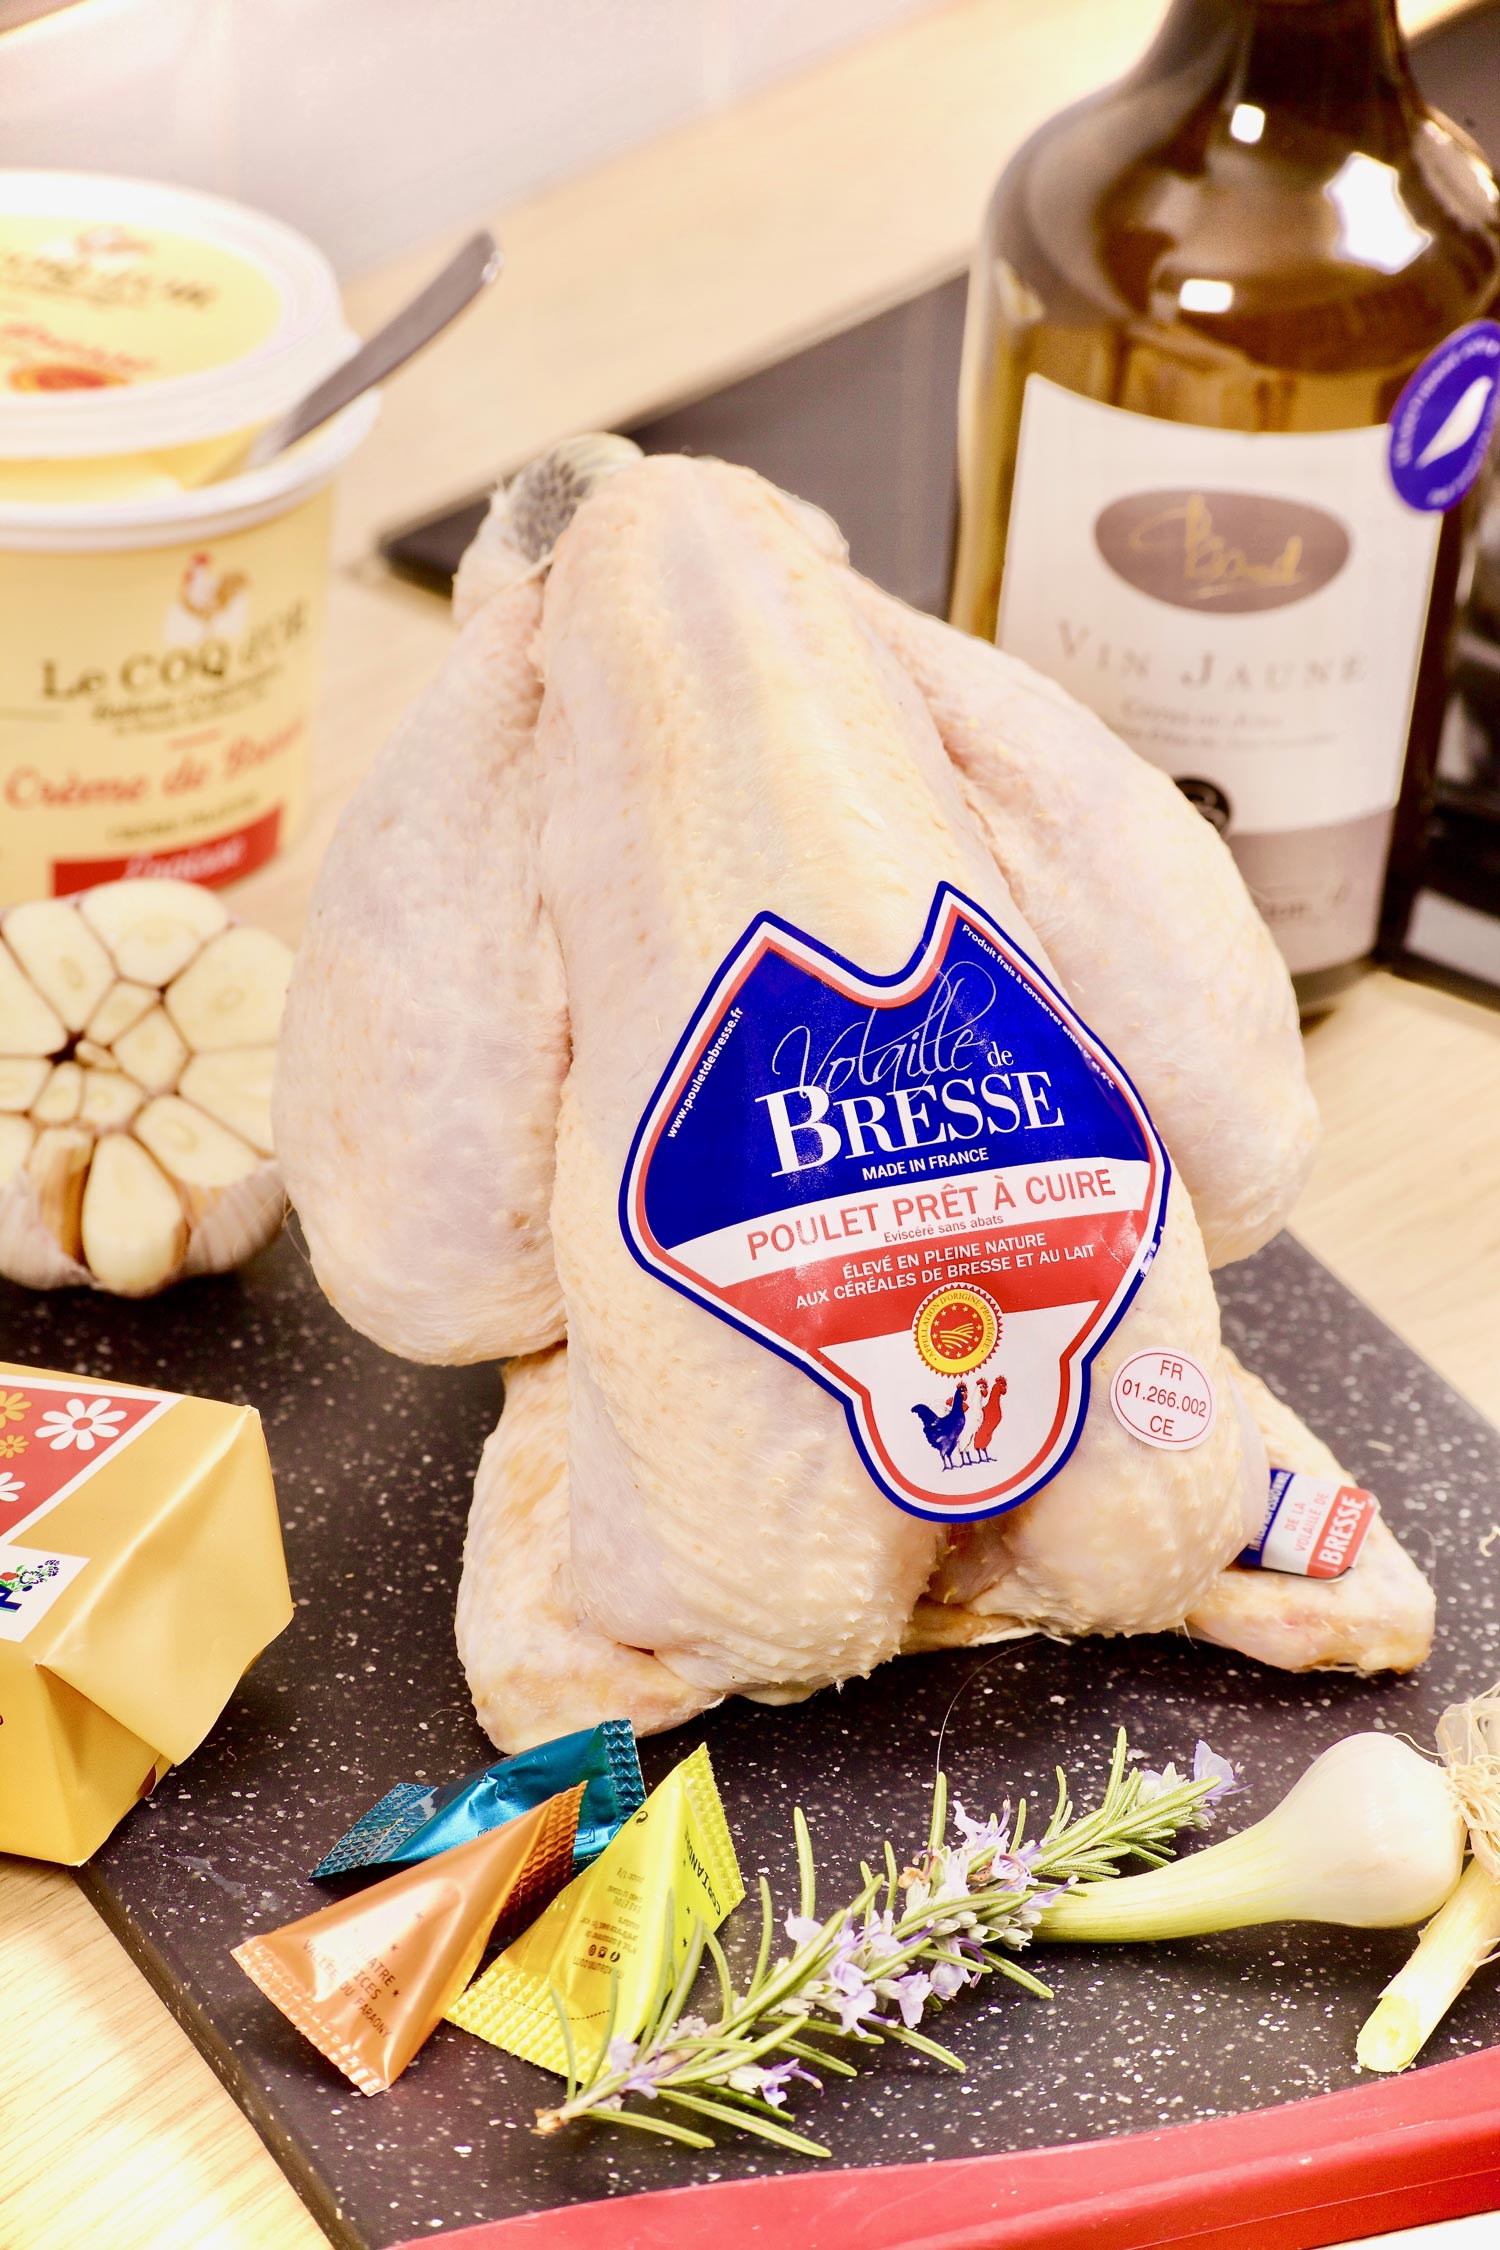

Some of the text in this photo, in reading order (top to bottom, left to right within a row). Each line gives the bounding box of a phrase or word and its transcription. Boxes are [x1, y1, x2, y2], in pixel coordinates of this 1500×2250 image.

[962, 924, 997, 959] Produit
[996, 955, 1016, 978] frais
[1015, 973, 1023, 985] à
[1022, 983, 1063, 1026] conserver
[1062, 1025, 1083, 1051] entre
[772, 961, 1014, 1100] Volaille de
[667, 1007, 744, 1139] www.pouletdebresse.fr
[755, 1070, 1065, 1178] BRESSE
[861, 1147, 990, 1181] MADE IN FRANCE
[746, 1168, 1116, 1262] POULET PRÊT À CUIRE
[883, 1214, 1004, 1244] Eviscéré sans abats
[795, 1244, 1095, 1310] AUX CÉRÉALES DE BRESSE ET AU LAIT
[842, 1233, 1047, 1280] ÉLEVÉ EN PLEINE NATURE
[939, 1292, 983, 1308] D'ORIGINE
[1159, 1359, 1183, 1381] FR
[1121, 1379, 1207, 1418] 01.266.002
[1149, 1415, 1175, 1437] CE
[1284, 1518, 1299, 1532] DE
[1294, 1508, 1322, 1552] VOLAILLE
[1317, 1494, 1367, 1566] BRESSE
[338, 1979, 355, 1997] DU
